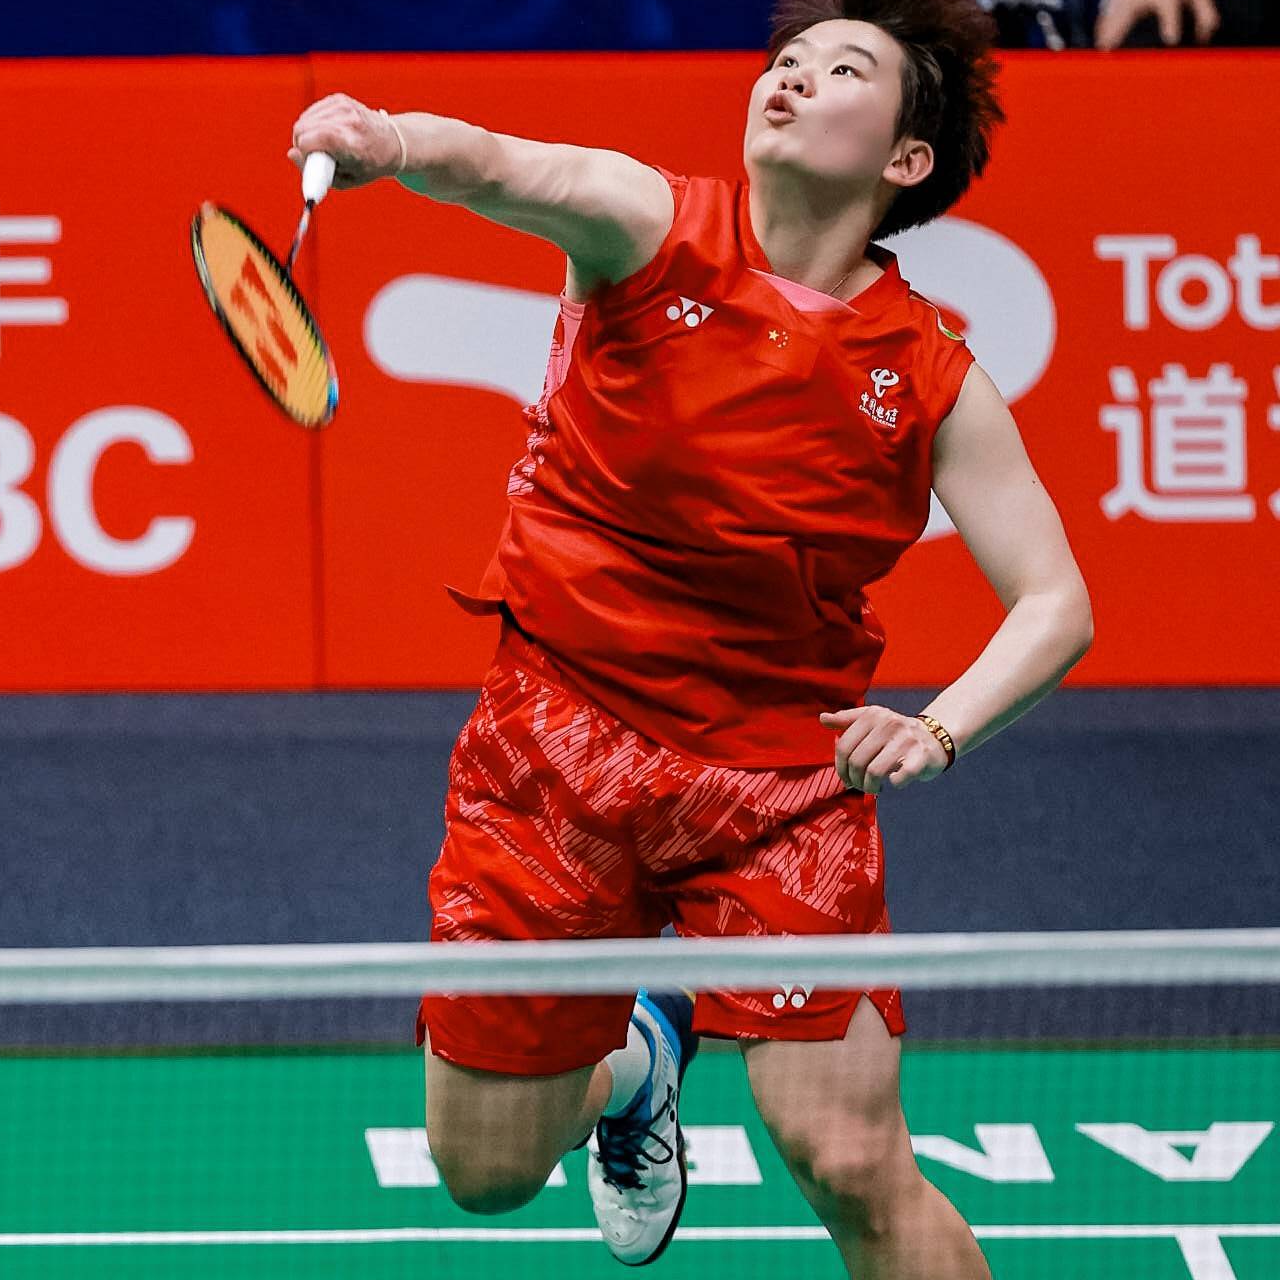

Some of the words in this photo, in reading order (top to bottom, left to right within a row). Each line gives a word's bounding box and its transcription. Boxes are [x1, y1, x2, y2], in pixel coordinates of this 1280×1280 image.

[860, 391, 899, 423] 中国电信
[1097, 362, 1280, 523] 道
